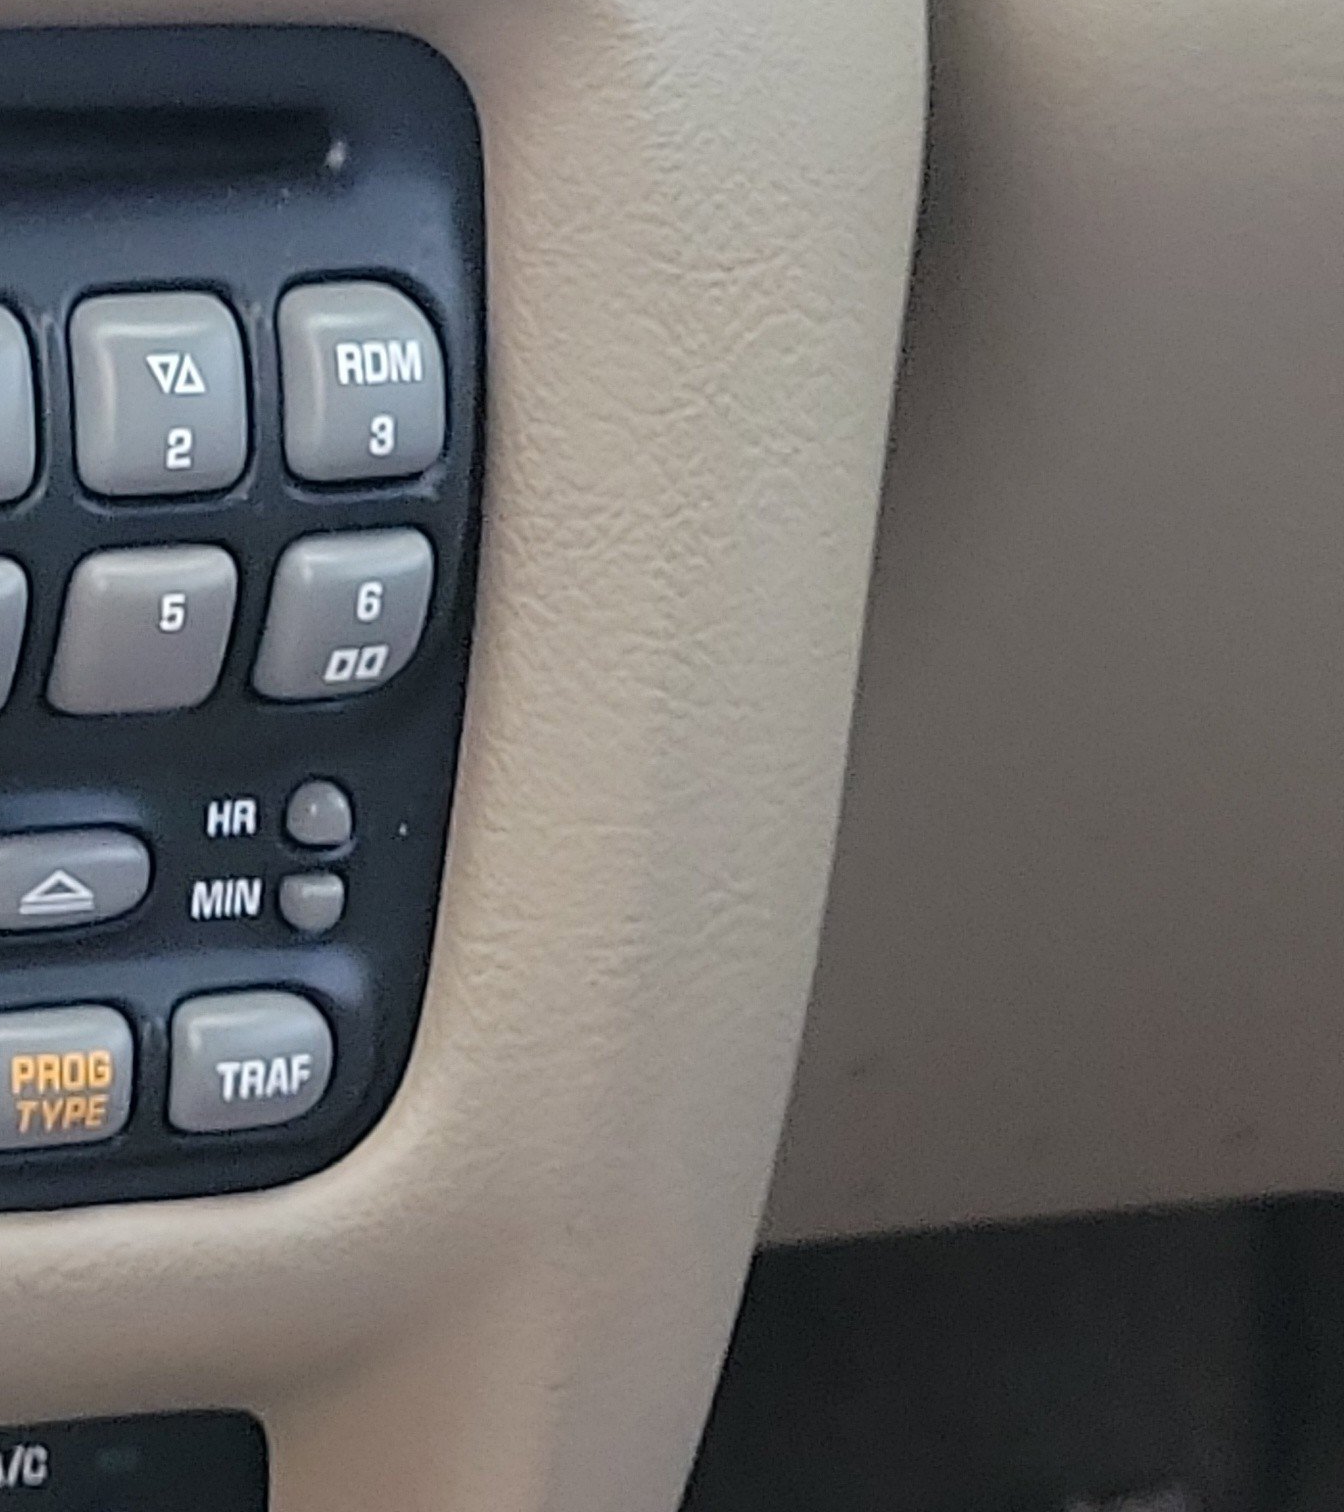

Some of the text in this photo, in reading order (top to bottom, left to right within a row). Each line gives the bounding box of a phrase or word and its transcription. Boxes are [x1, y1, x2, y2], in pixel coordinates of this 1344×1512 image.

[336, 341, 423, 384] RDM
[166, 429, 193, 469] 2
[368, 416, 395, 456] 3
[158, 594, 186, 631] 5
[356, 582, 384, 621] 6
[206, 798, 257, 837] HR
[190, 878, 262, 921] MIN
[11, 1049, 111, 1094] PROG
[216, 1053, 312, 1102] TRAF
[16, 1094, 108, 1135] TYPE
